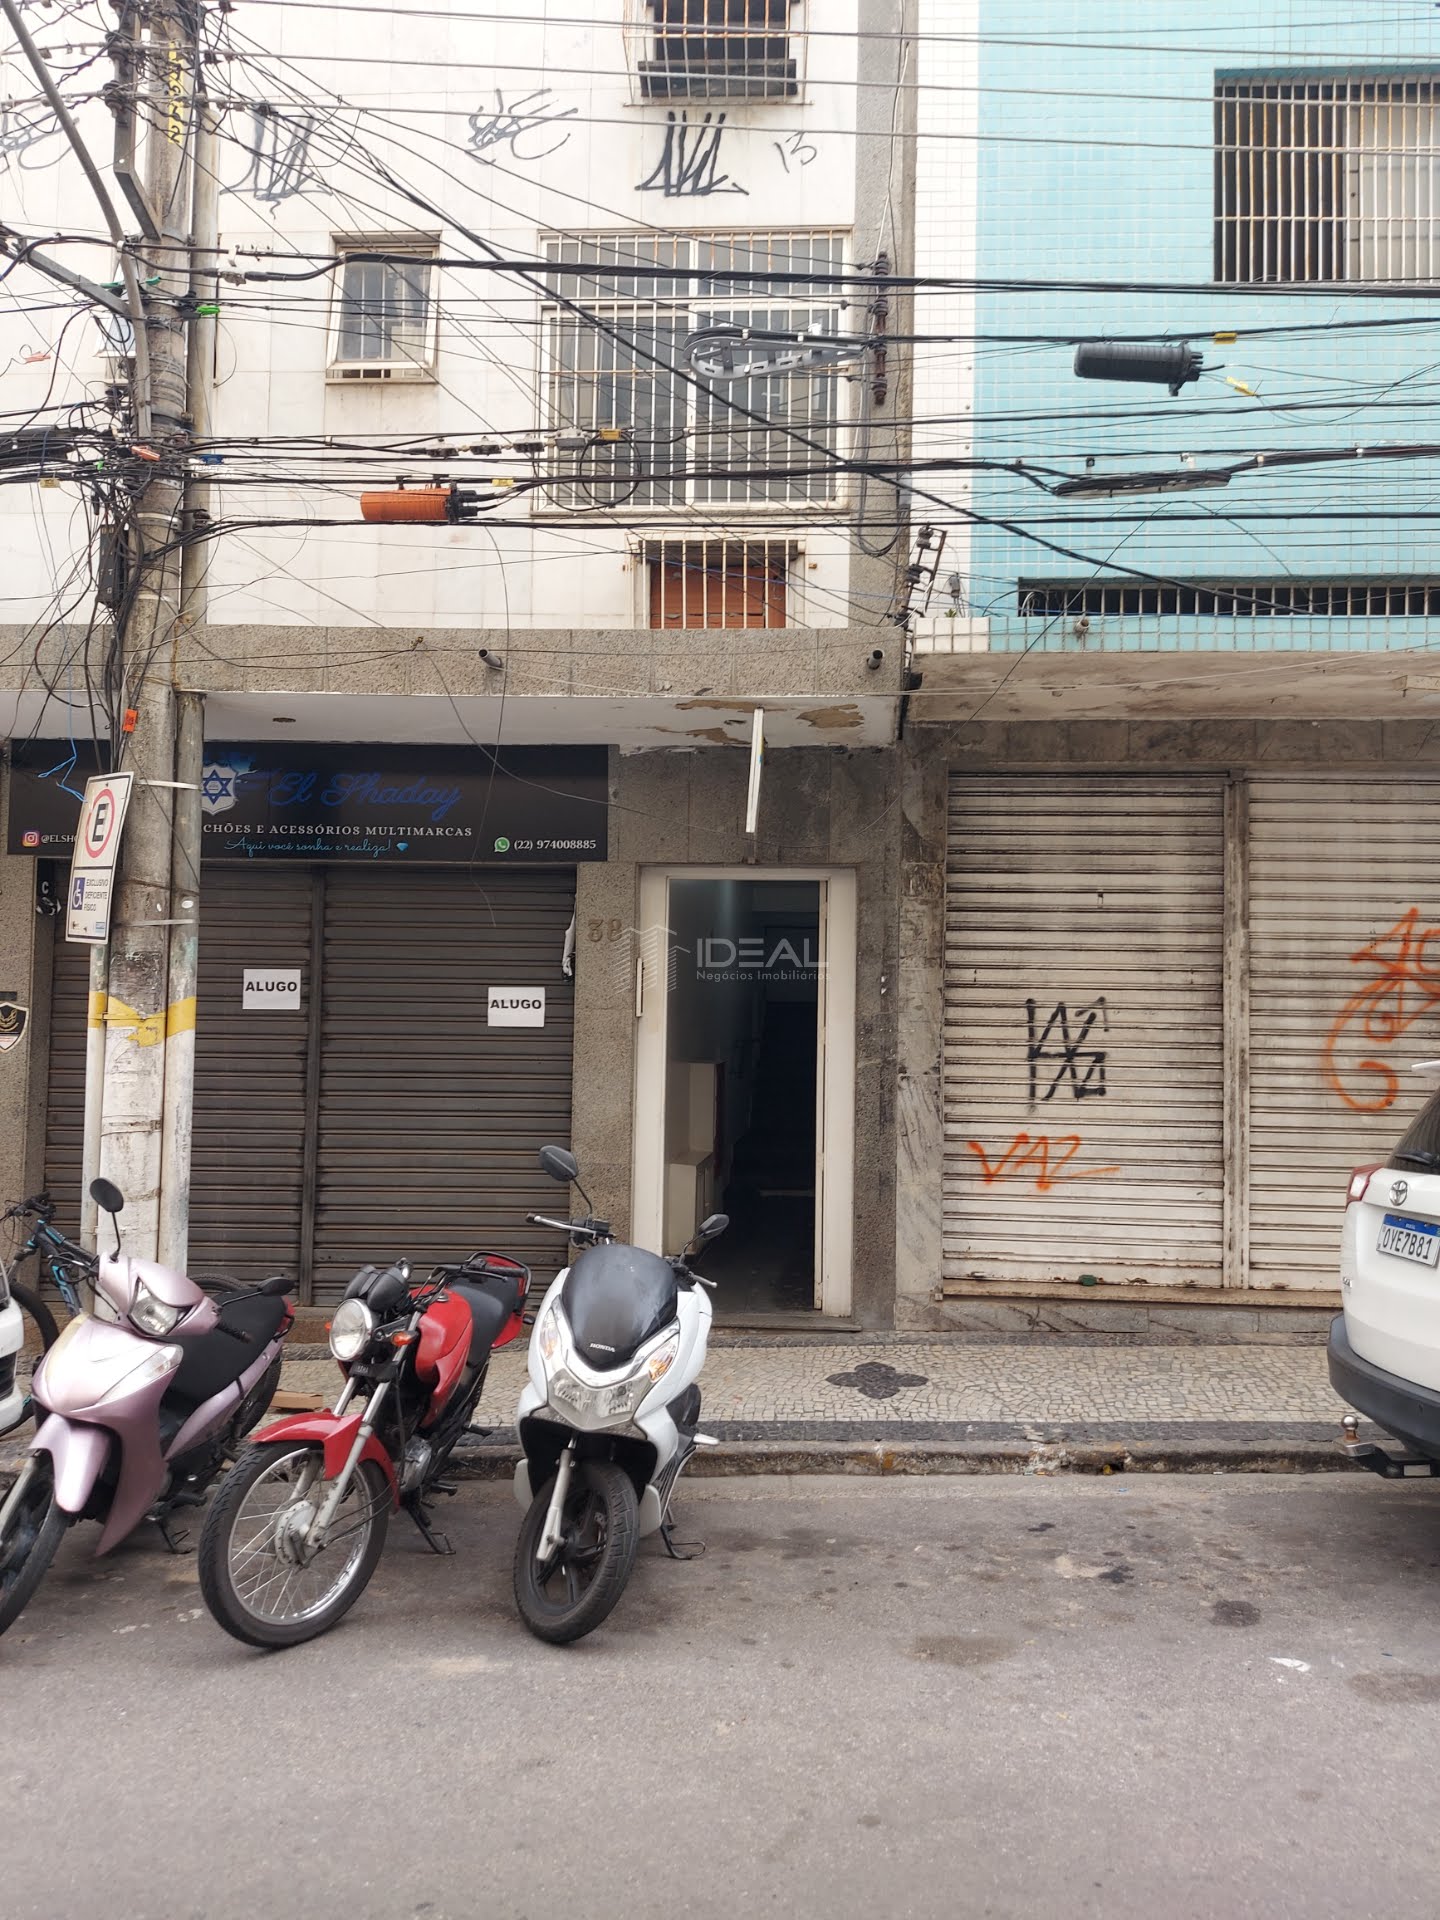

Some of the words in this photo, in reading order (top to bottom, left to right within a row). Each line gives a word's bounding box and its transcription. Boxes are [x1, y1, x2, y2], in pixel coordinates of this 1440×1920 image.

[92, 803, 109, 842] E
[203, 822, 251, 834] CHÕES
[256, 824, 265, 834] E
[269, 824, 361, 835] ACESSÓRIOS
[365, 826, 472, 836] MULTIMARCAS
[224, 837, 266, 857] Aqui
[296, 838, 333, 851] sonha
[514, 839, 533, 851] (22)
[536, 839, 596, 850] 974008885
[86, 878, 109, 887] EXCLUSIVO
[84, 891, 108, 900] DEFICIENTE
[245, 981, 298, 992] ALUGO
[489, 999, 543, 1010] ALUGO
[589, 1343, 616, 1353] HONDA
